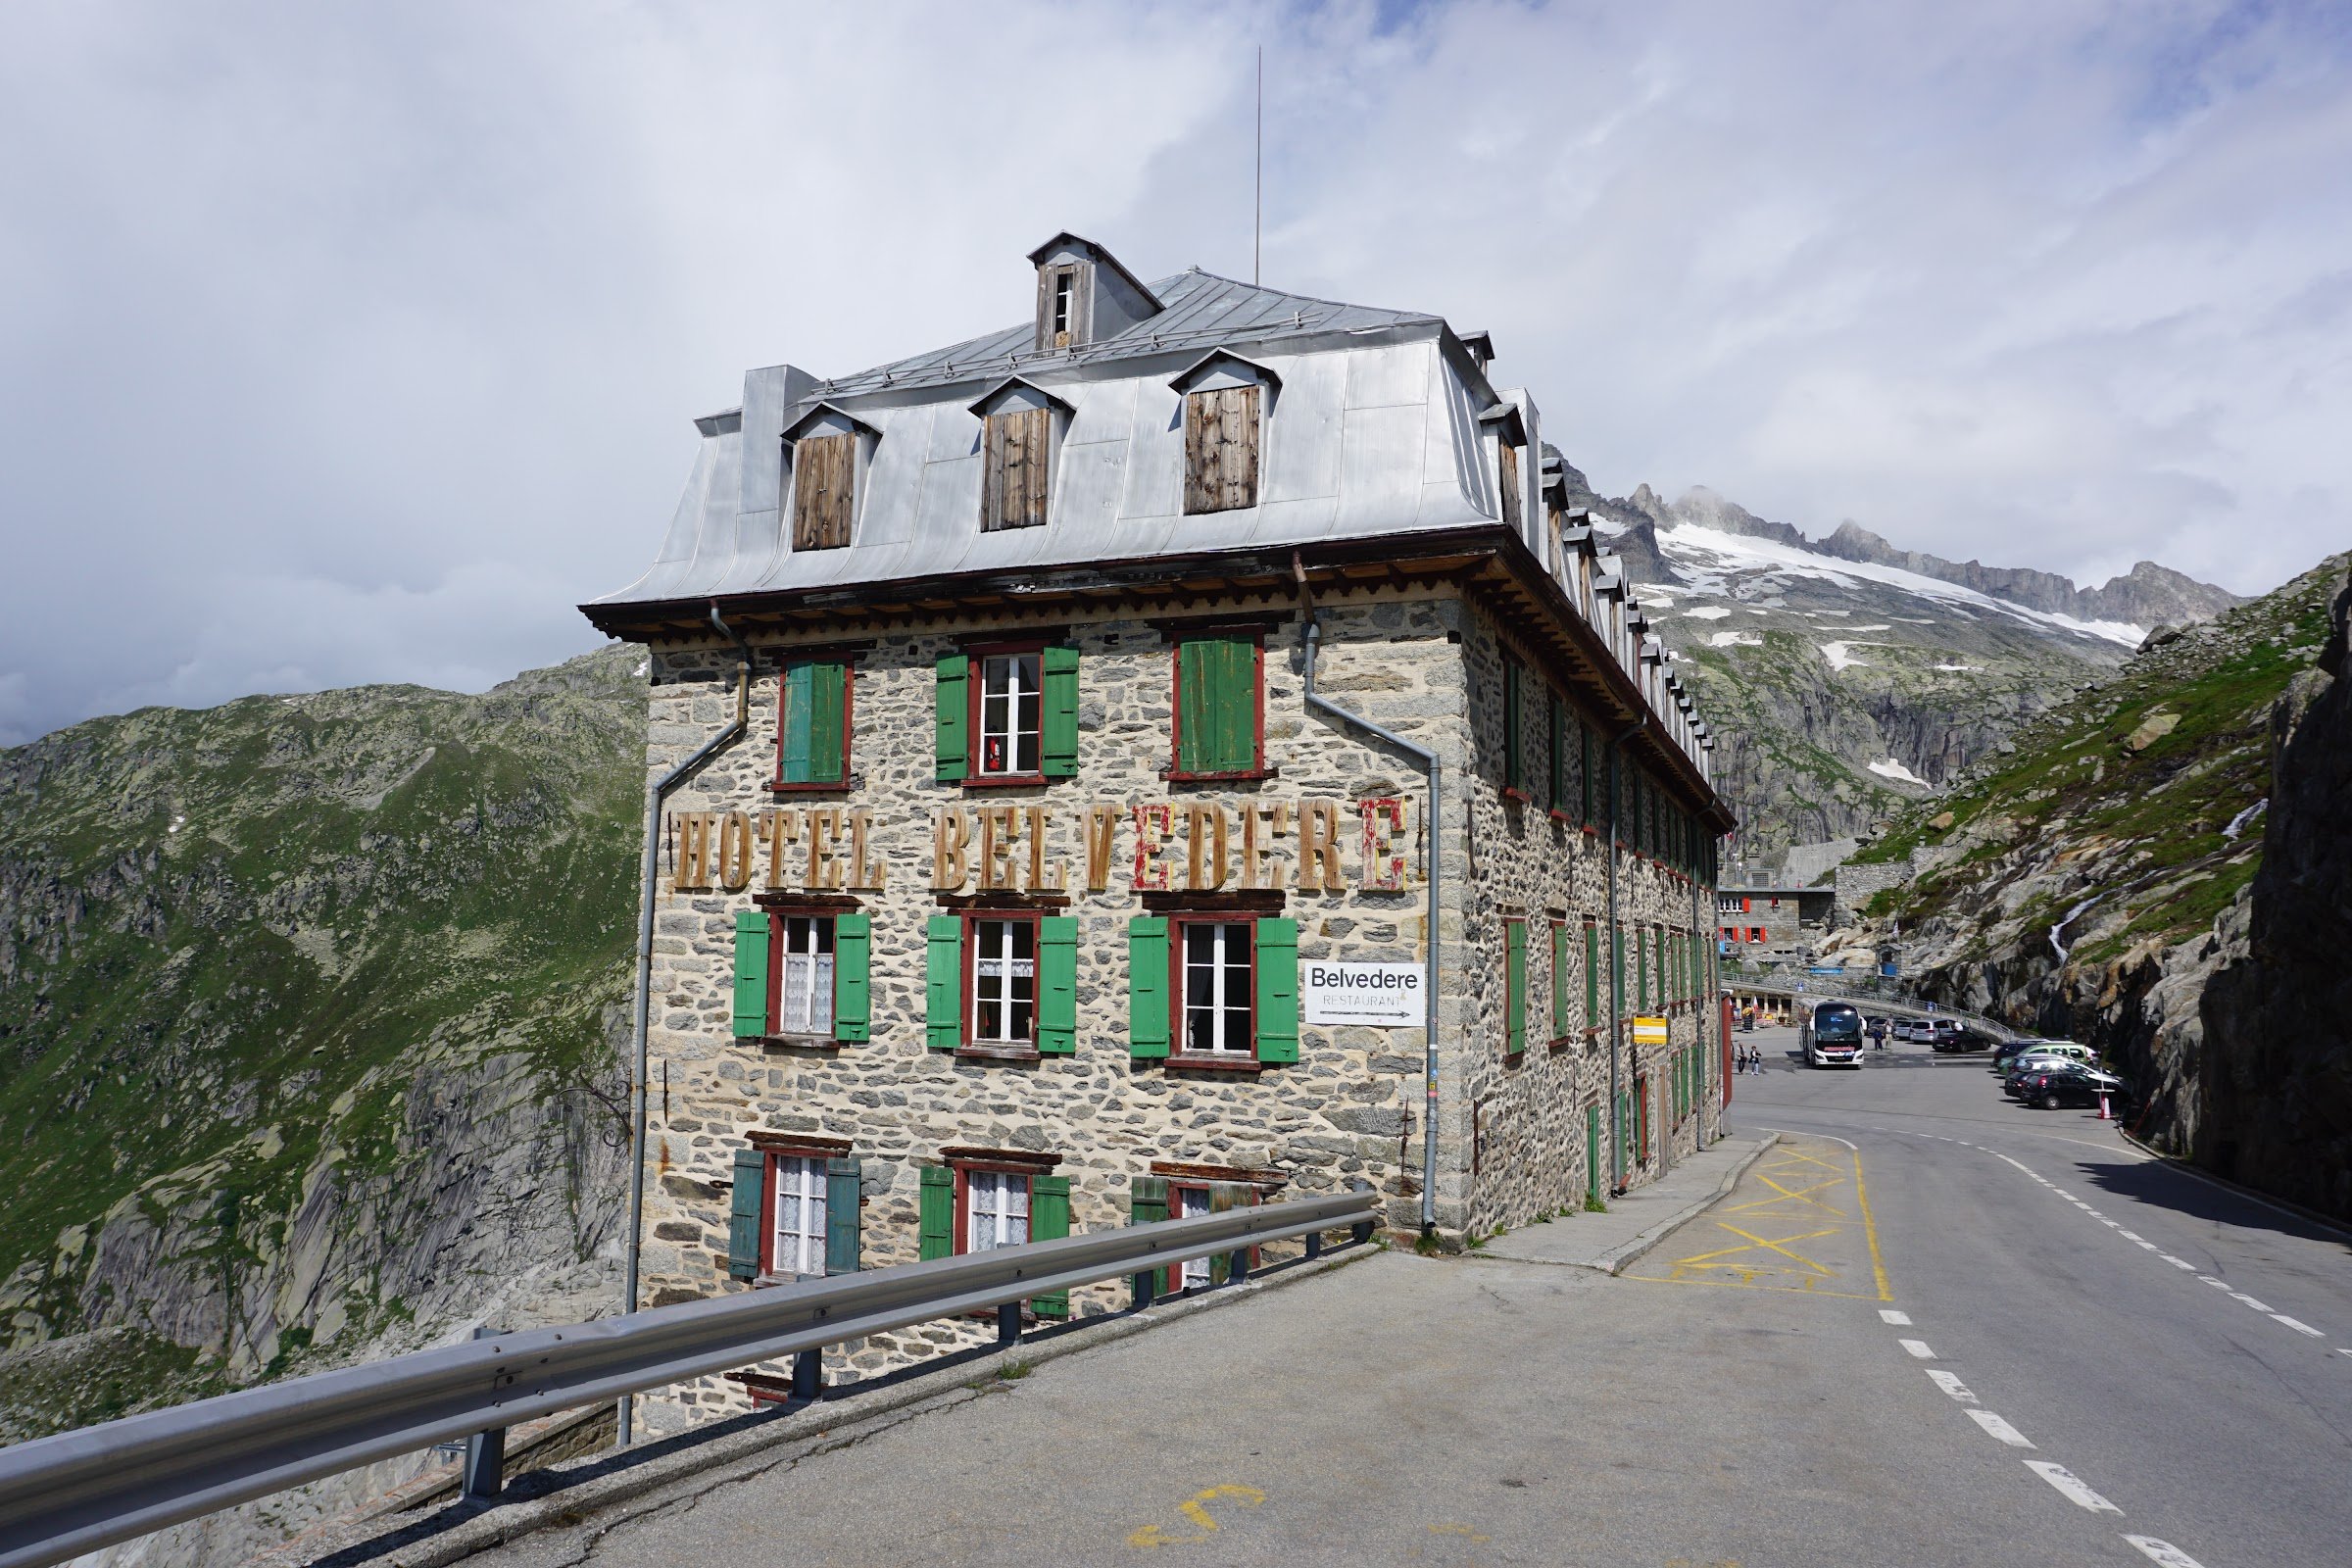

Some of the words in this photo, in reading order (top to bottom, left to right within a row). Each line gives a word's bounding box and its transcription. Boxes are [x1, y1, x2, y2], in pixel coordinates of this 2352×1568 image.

[674, 808, 886, 890] HOTEL
[930, 796, 1407, 892] BELVEDERE
[1311, 967, 1418, 989] Belvedere
[1323, 995, 1400, 1006] RESTAURANT
